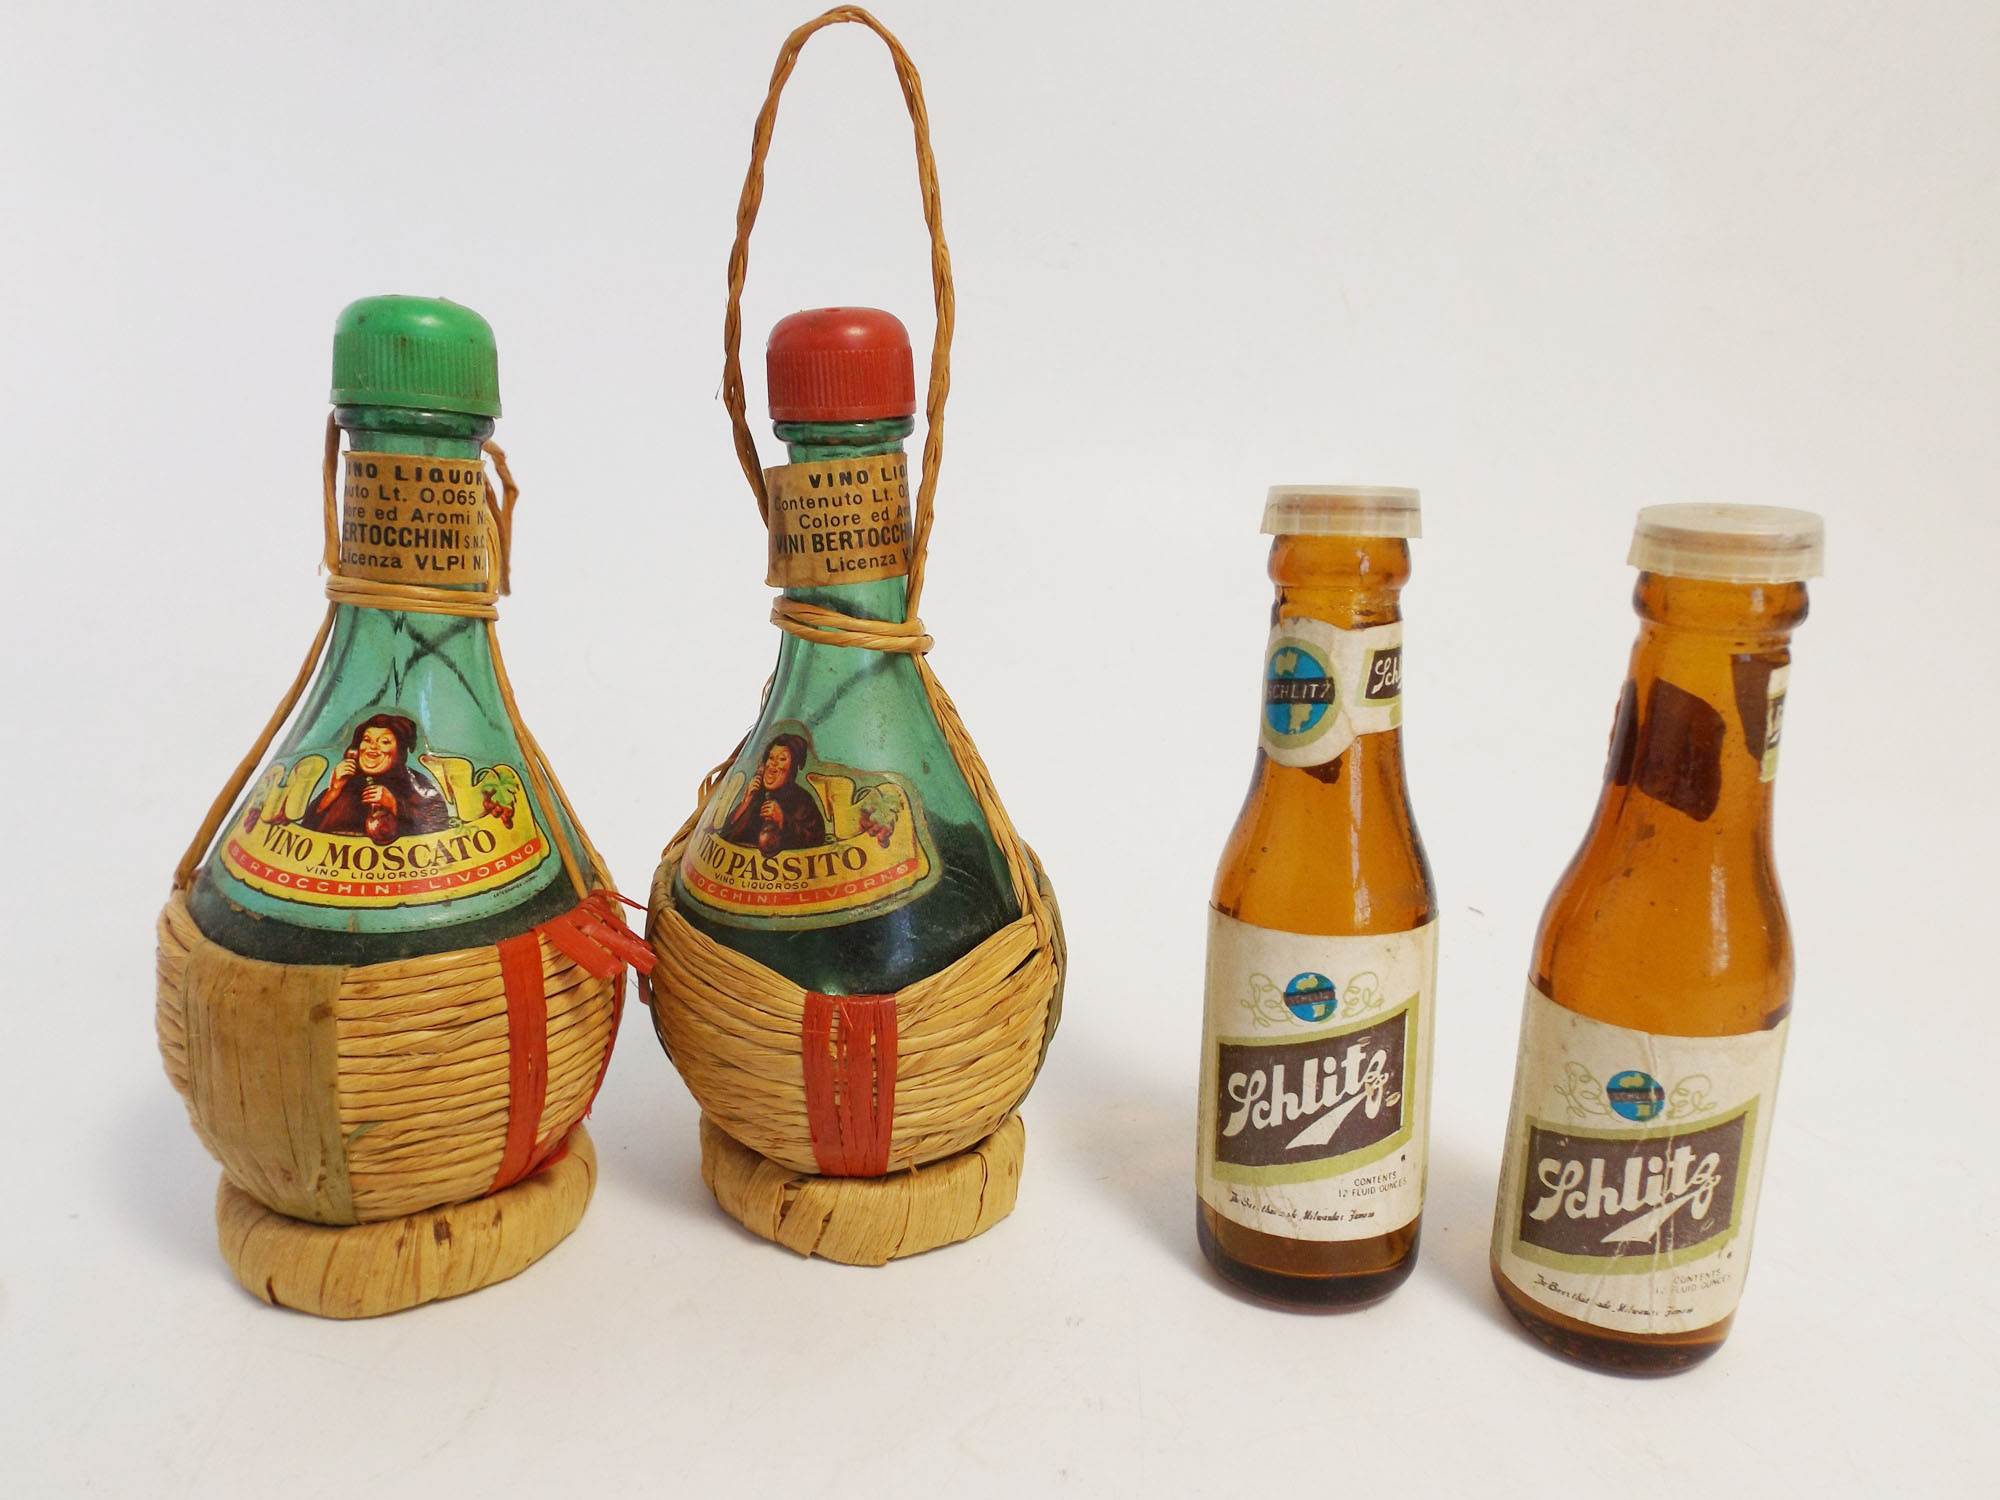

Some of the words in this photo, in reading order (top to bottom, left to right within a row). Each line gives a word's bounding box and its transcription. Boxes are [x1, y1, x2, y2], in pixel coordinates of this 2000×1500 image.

[808, 469, 869, 488] VINO
[379, 485, 407, 503] Lt.
[774, 492, 863, 512] Contenuto
[872, 487, 894, 503] Lt.
[375, 507, 398, 521] ed
[411, 508, 470, 525] Aromi
[799, 512, 861, 530] Colore
[871, 506, 889, 522] ed
[775, 533, 806, 555] VINI
[414, 554, 465, 571] VLPI
[825, 553, 897, 573] Licenza
[262, 822, 313, 862] VINO
[319, 829, 496, 871] MOSCATO
[306, 864, 339, 878] VINO
[351, 866, 438, 880] LIQUOROSO
[429, 843, 535, 889] LIVORNO
[726, 846, 867, 882] PASSITO
[715, 872, 735, 885] VINO
[741, 881, 809, 890] LIQUOROSO
[1222, 1044, 1389, 1150] Schlitz
[1354, 1171, 1397, 1187] CONTENTS
[1352, 1186, 1376, 1197] FLUID
[1529, 1145, 1722, 1244] Schlitz
